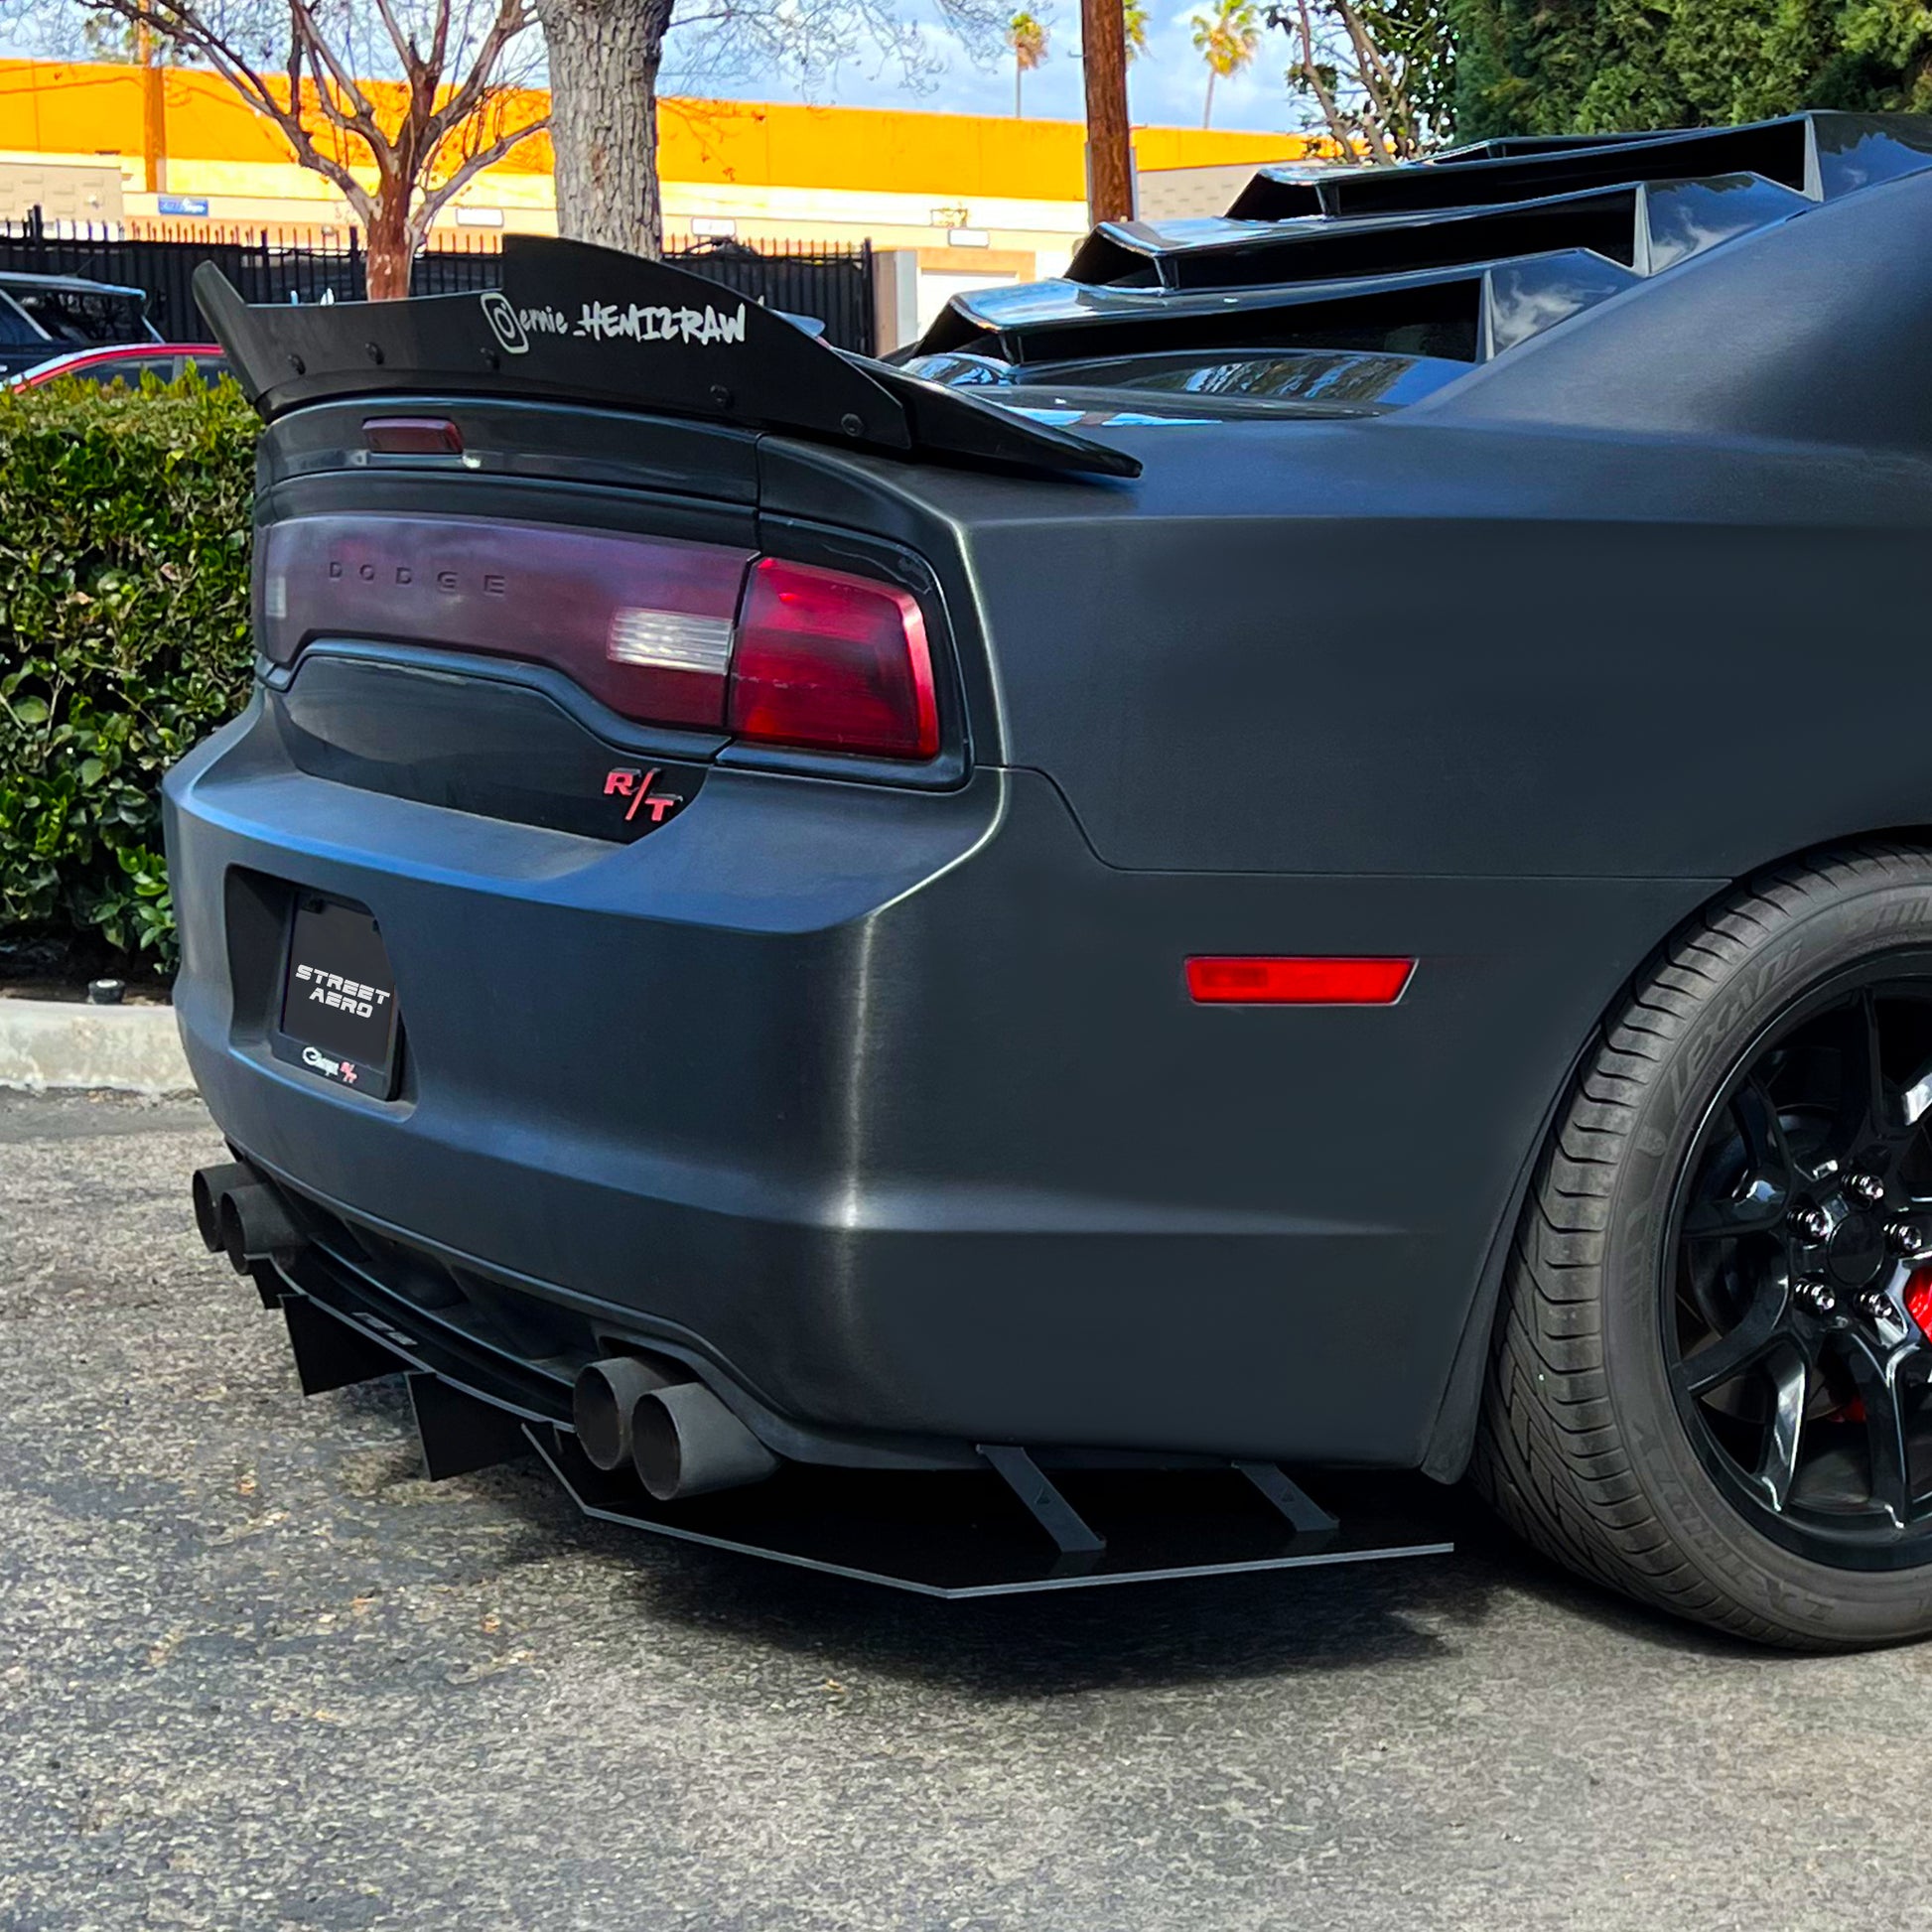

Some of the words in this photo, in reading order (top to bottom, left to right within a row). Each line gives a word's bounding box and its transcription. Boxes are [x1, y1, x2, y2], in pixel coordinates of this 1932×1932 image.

[329, 561, 506, 595] DODGE
[603, 767, 684, 822] R/T
[295, 964, 391, 1005] STREET
[309, 987, 373, 1019] AERO
